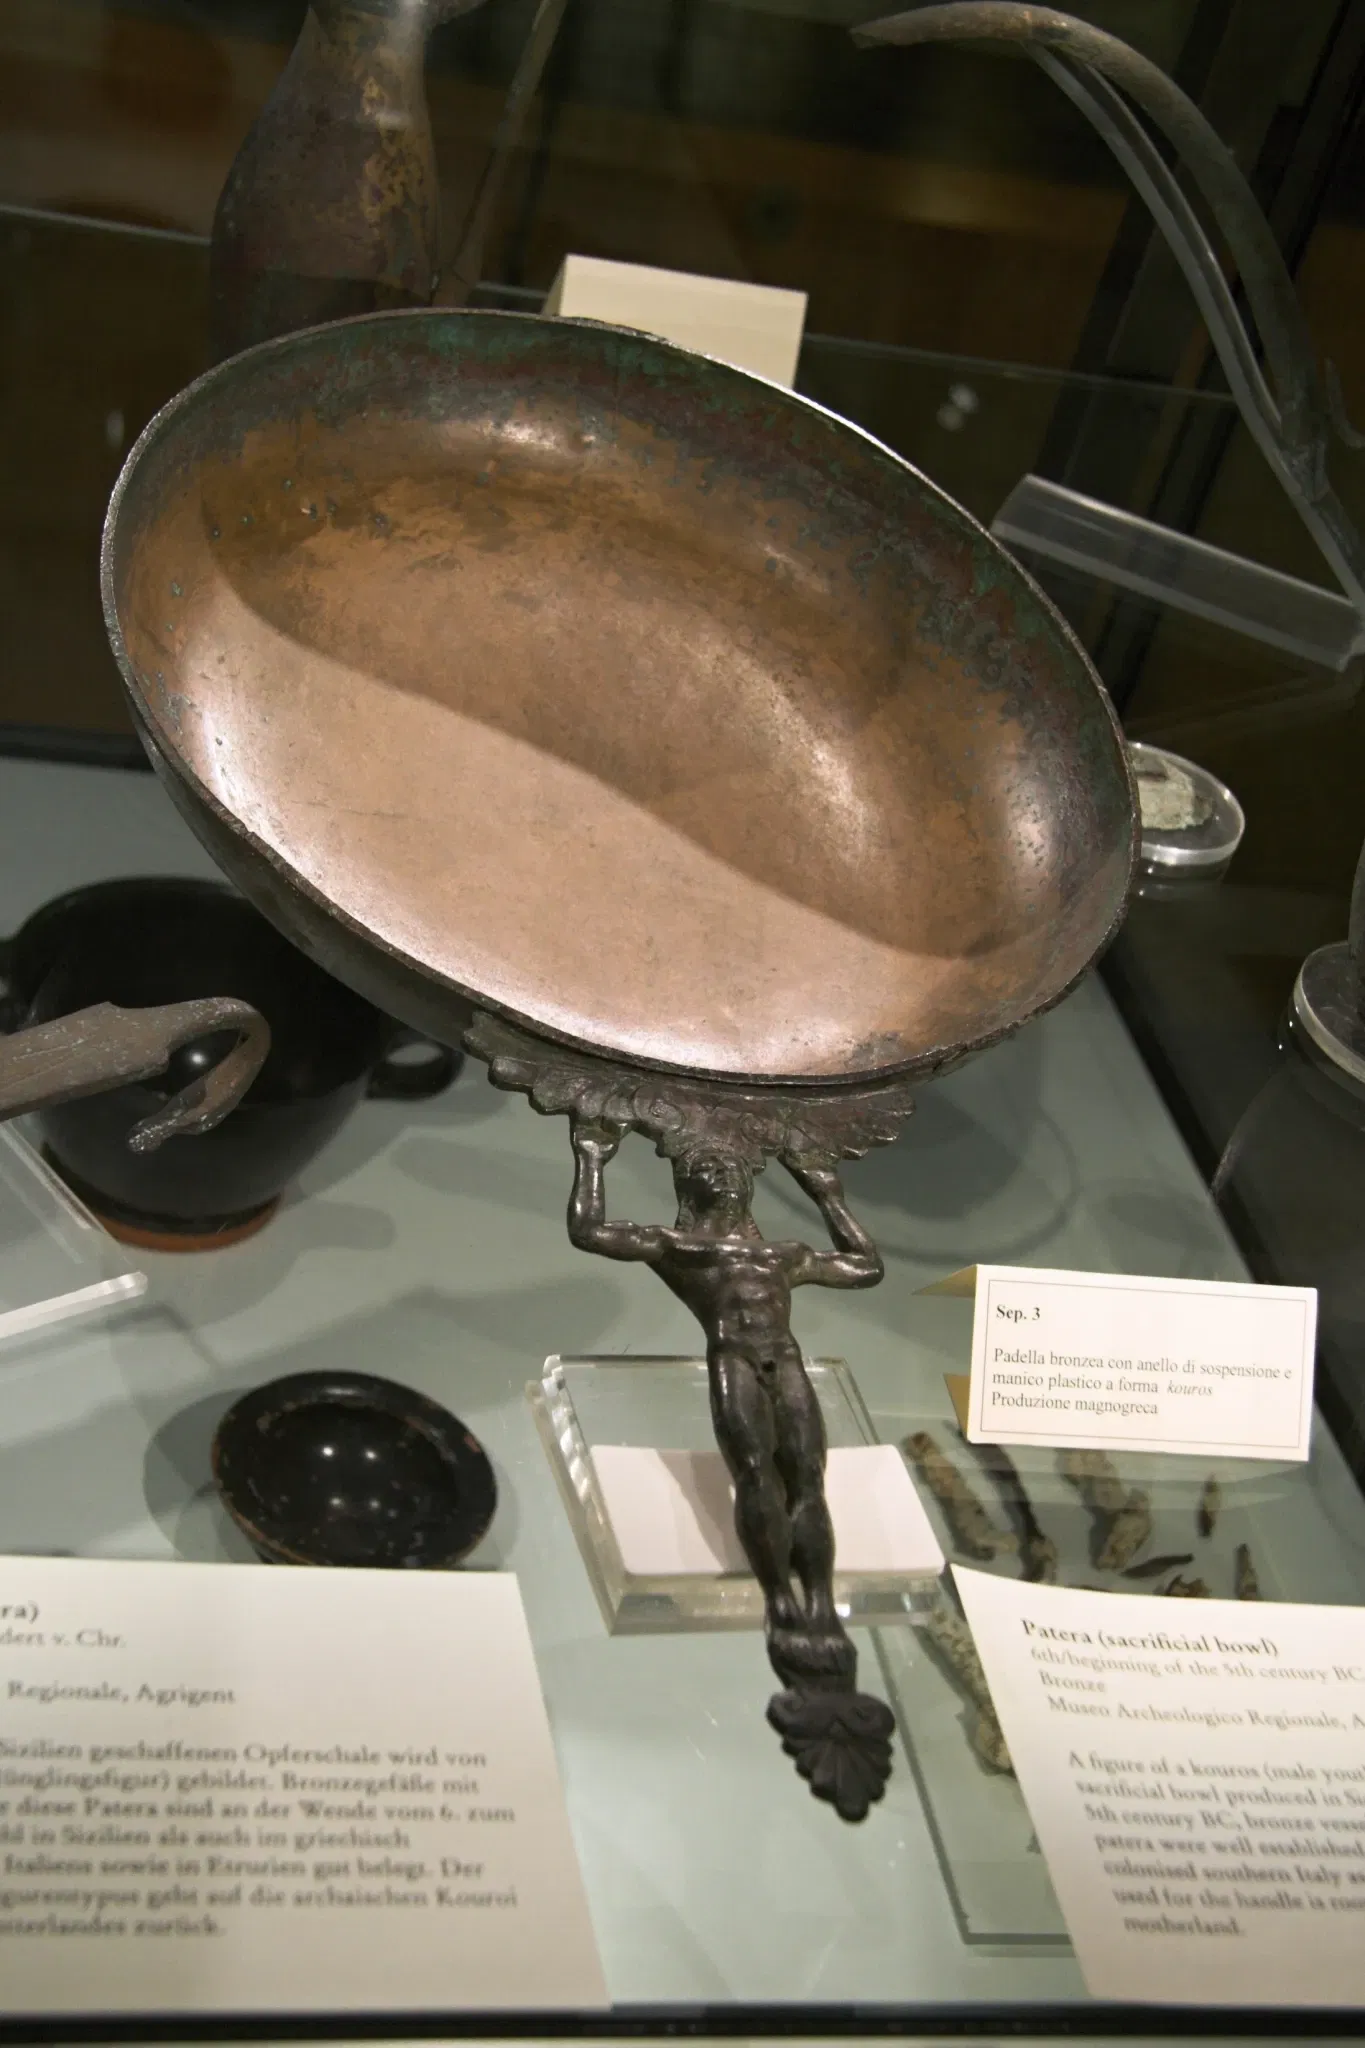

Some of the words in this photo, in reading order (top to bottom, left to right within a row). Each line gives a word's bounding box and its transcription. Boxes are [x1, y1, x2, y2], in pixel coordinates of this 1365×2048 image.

[996, 1305, 1027, 1324] Sep.
[1032, 1307, 1041, 1321] 3
[994, 1348, 1045, 1365] Padella
[1050, 1352, 1104, 1369] bronzea
[1108, 1358, 1133, 1370] con
[1137, 1356, 1178, 1373] anello
[1183, 1358, 1196, 1374] di
[1200, 1362, 1281, 1380] sospensione
[1284, 1368, 1292, 1379] e
[992, 1371, 1044, 1387] manico
[1048, 1373, 1102, 1391] plastico
[1106, 1380, 1114, 1390] a
[1118, 1379, 1158, 1394] forma
[1167, 1381, 1213, 1397] kouros
[992, 1392, 1071, 1410] Produzione
[1075, 1399, 1158, 1415] magnogreca
[1020, 1617, 1092, 1644] Patera
[1098, 1629, 1212, 1653] (sacrificial
[1213, 1635, 1278, 1658] bowl)
[1030, 1646, 1161, 1677] 6th/beginning
[1164, 1658, 1183, 1674] of
[1188, 1660, 1218, 1677] the
[1222, 1661, 1253, 1677] 5th
[1258, 1665, 1329, 1684] century
[8, 1680, 129, 1703] Regionale,
[135, 1683, 236, 1707] Agrigent
[1038, 1669, 1105, 1692] Bronze
[1047, 1694, 1110, 1717] Museo
[1117, 1702, 1243, 1728] Archeologico
[1245, 1708, 1347, 1731] Regionale,
[88, 1739, 238, 1764] geschaffenen
[243, 1743, 380, 1767] Opferschale
[388, 1745, 438, 1766] wird
[445, 1751, 487, 1767] von
[1069, 1750, 1085, 1768] A
[1089, 1750, 1145, 1776] figure
[1150, 1755, 1170, 1774] of
[1176, 1763, 1187, 1776] a
[1320, 1763, 1365, 1785] yout
[1075, 1777, 1166, 1800] sacrificial
[1168, 1782, 1220, 1803] bowl
